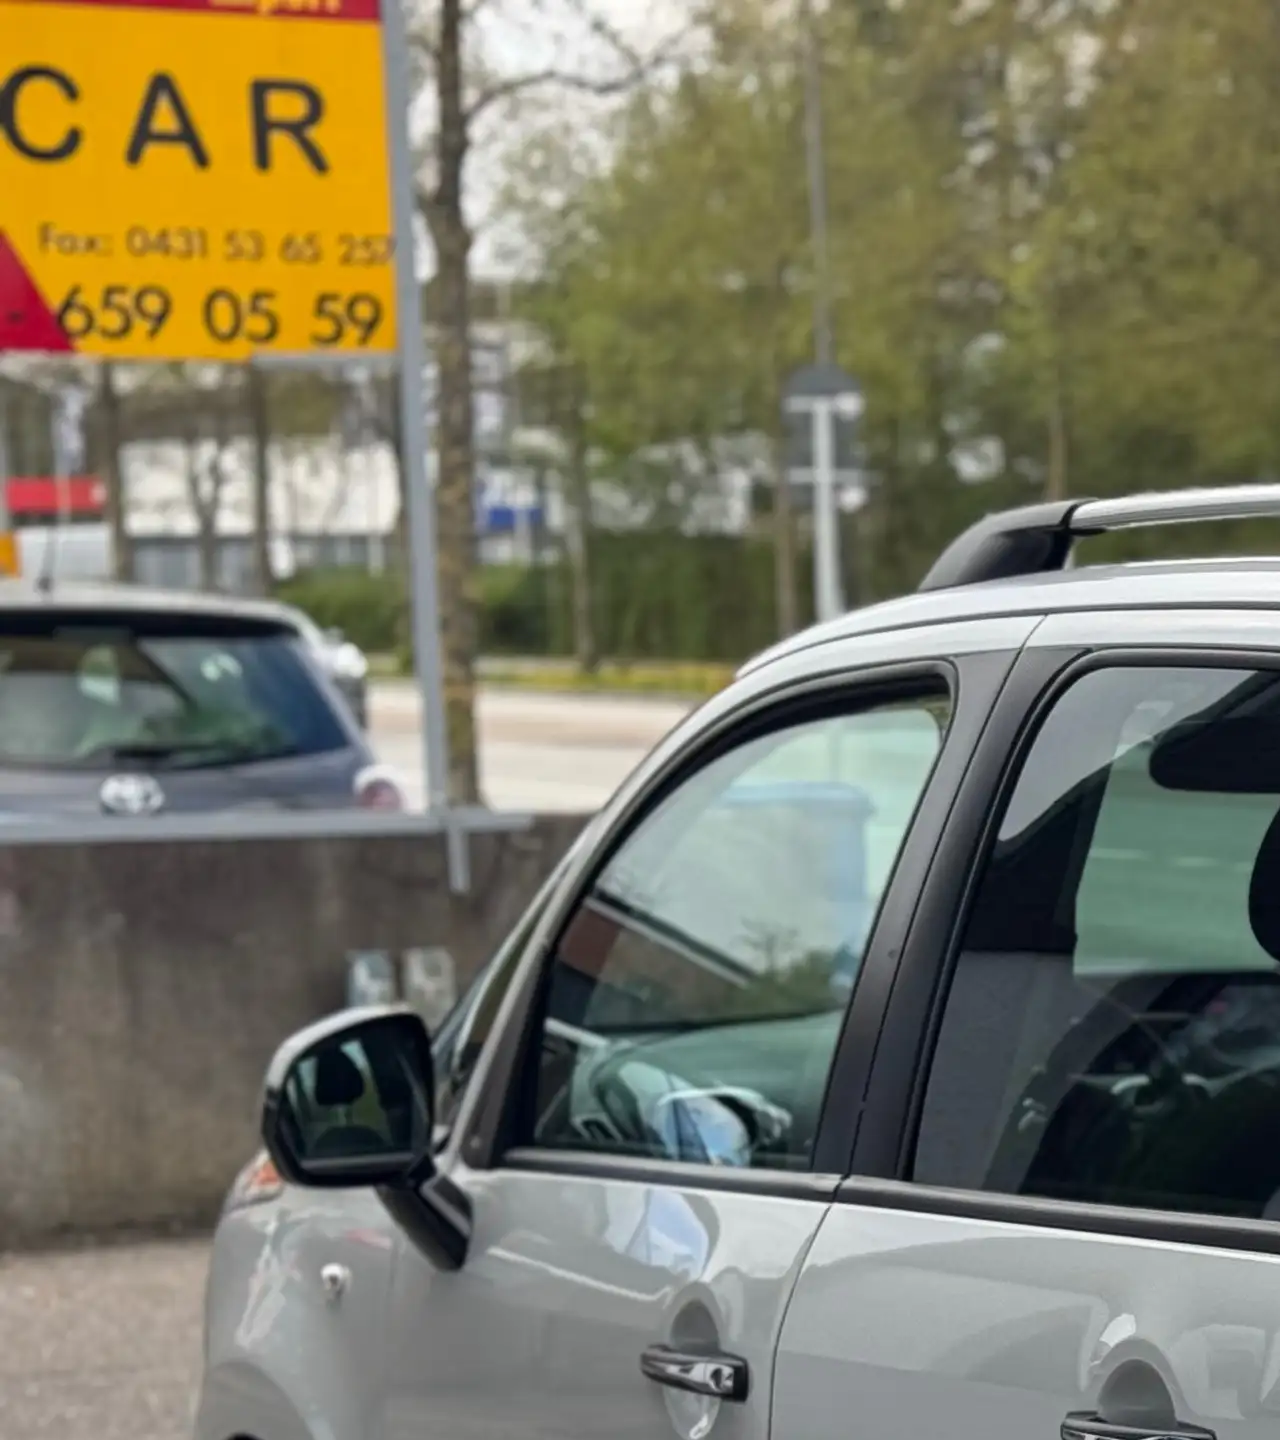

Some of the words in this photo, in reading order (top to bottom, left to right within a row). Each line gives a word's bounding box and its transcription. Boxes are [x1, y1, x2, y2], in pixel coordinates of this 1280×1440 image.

[125, 225, 208, 260] 0431
[56, 284, 173, 341] 659
[203, 287, 280, 343] 05
[309, 292, 384, 346] 59
